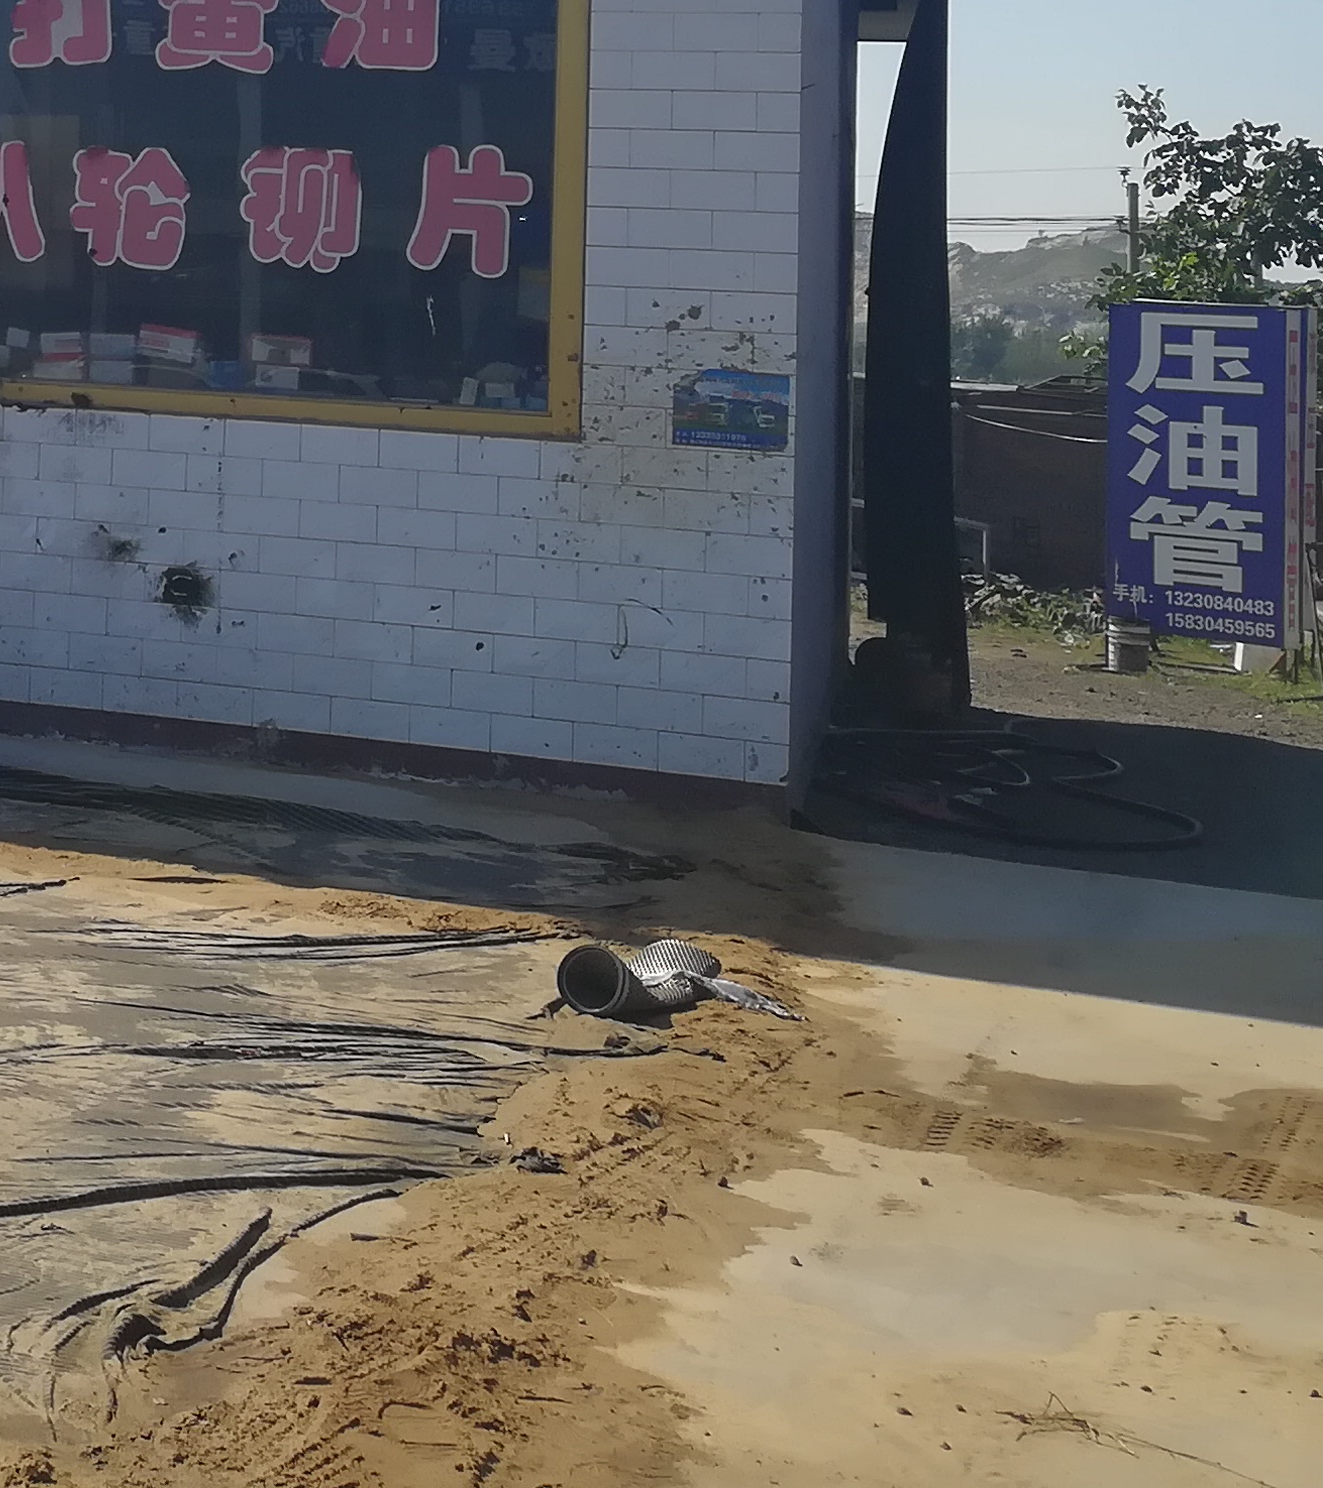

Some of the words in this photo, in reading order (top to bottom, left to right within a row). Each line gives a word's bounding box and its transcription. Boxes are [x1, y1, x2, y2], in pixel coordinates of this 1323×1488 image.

[1124, 312, 1264, 593] 压油管
[1164, 612, 1277, 640] 15830459565
